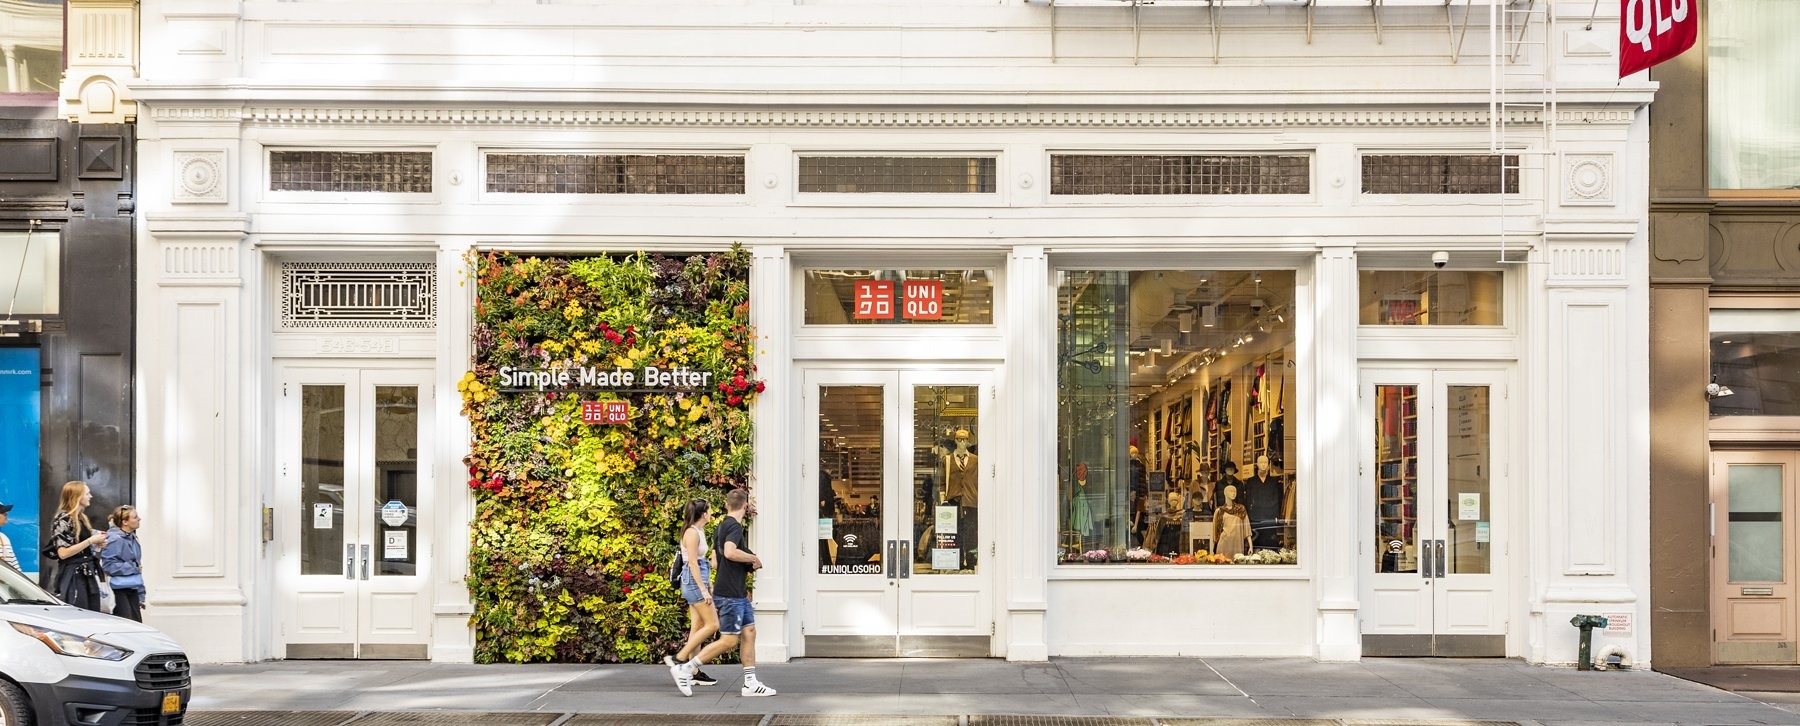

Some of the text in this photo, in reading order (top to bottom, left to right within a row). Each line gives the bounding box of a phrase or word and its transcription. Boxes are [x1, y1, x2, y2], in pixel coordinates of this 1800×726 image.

[860, 285, 889, 299] ユニ
[907, 285, 936, 299] UNI
[859, 301, 889, 315] クロ
[907, 301, 938, 317] QLO
[499, 366, 713, 391] Simple Made Better
[609, 404, 625, 413] UNI
[609, 413, 626, 422] QLO
[388, 537, 395, 545] D
[821, 564, 881, 575] #UNIQLOSOHO
